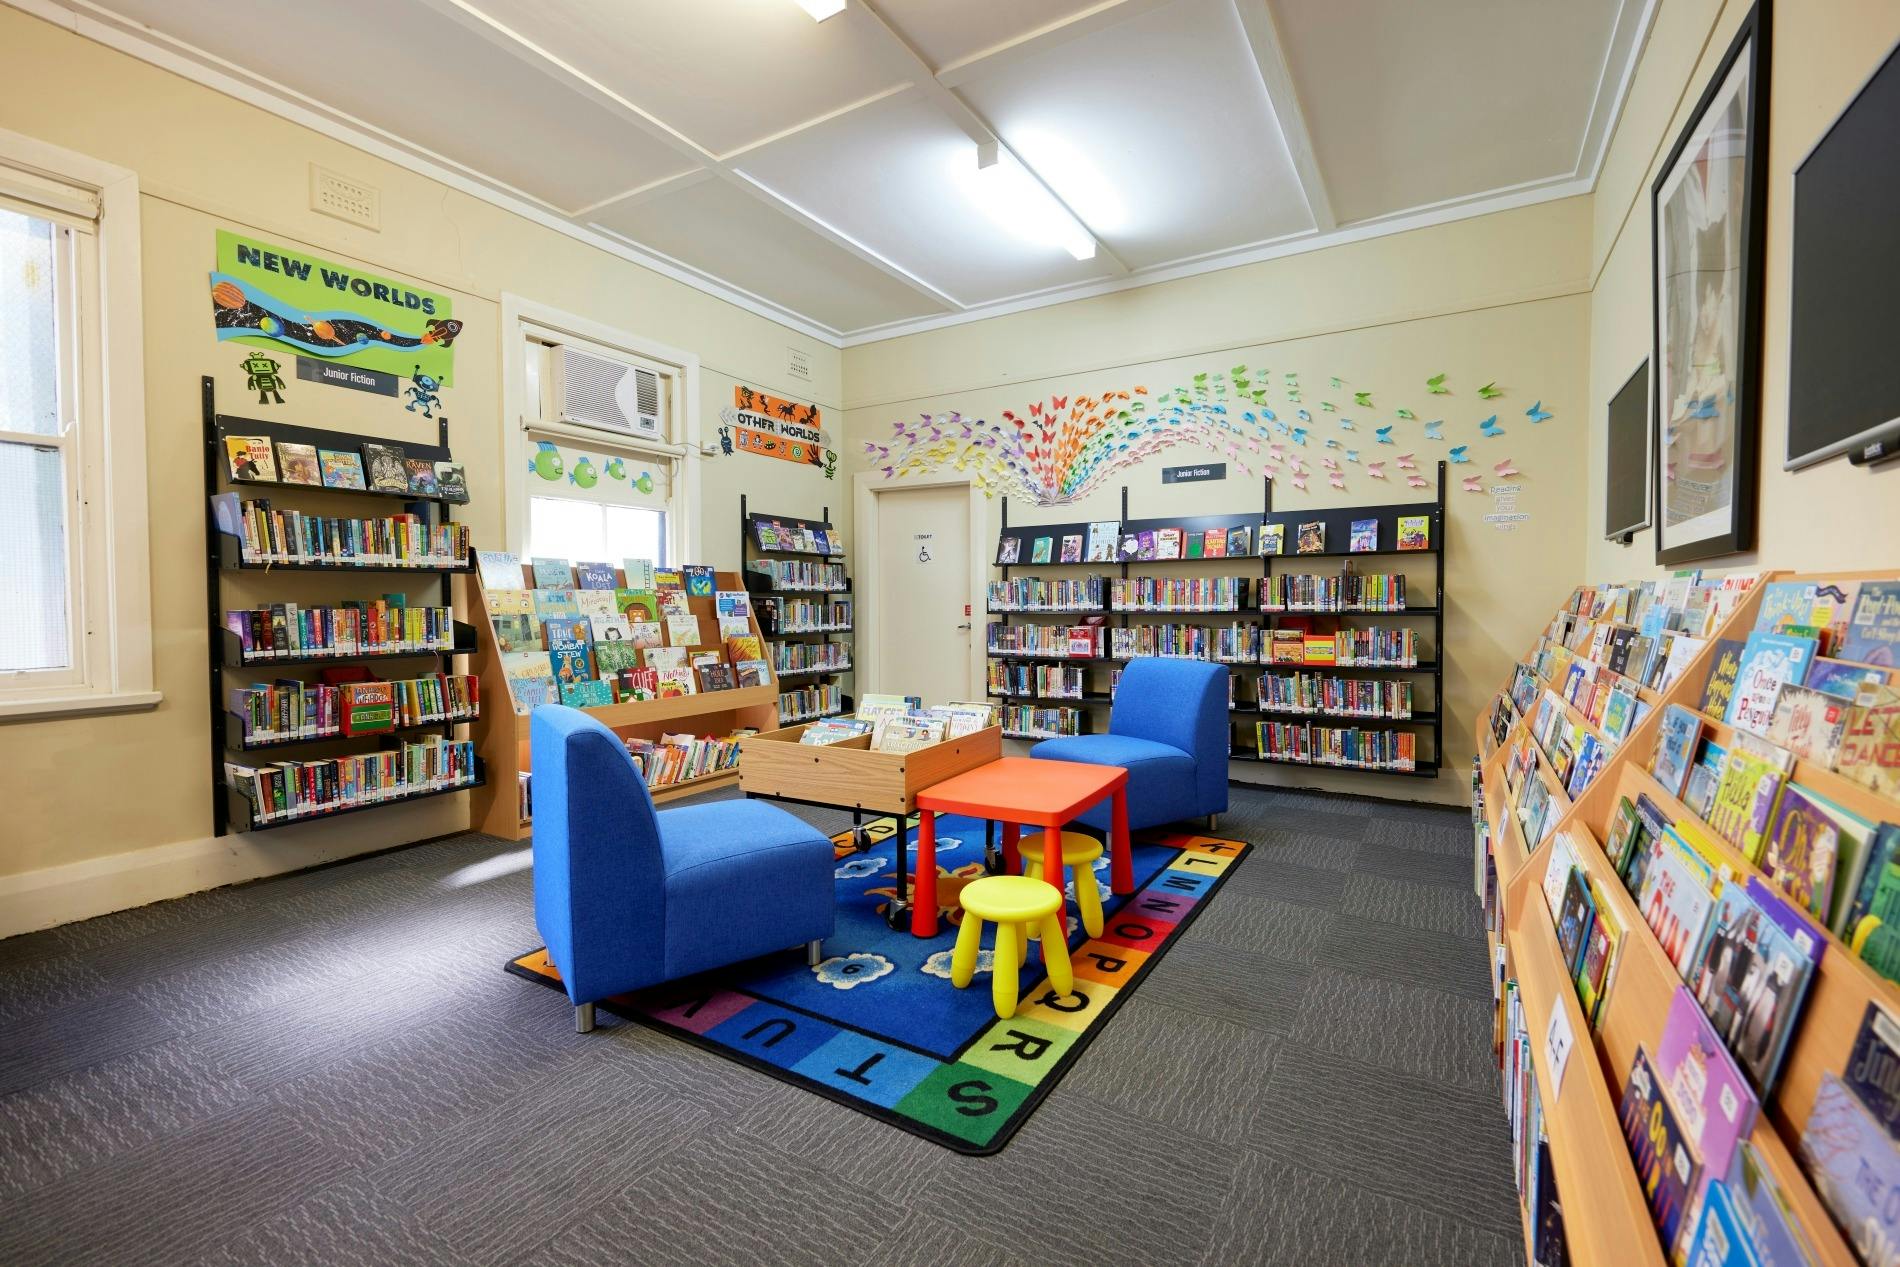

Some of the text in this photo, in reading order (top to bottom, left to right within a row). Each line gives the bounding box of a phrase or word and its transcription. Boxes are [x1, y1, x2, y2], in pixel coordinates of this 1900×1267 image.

[237, 244, 436, 315] NEW WORLDS
[323, 367, 375, 386] Junior Fiction
[737, 413, 820, 443] OTHER WORLDS
[246, 445, 270, 453] Banjo
[407, 461, 432, 470] RAVEN
[1177, 468, 1210, 478] Junior Fiction
[1490, 485, 1522, 494] Reading
[586, 572, 612, 582] KOALA
[552, 642, 584, 651] WOMBAT
[557, 650, 582, 659] STEW
[1753, 669, 1777, 692] Once
[1184, 857, 1218, 866] L
[1162, 875, 1202, 891] M
[1140, 897, 1180, 914] N
[1115, 923, 1154, 941] O
[1087, 952, 1127, 973] P
[1034, 989, 1090, 1013] Q
[741, 1018, 797, 1048] U
[989, 1029, 1053, 1061] R
[834, 1053, 886, 1086] T
[947, 1080, 998, 1117] S
